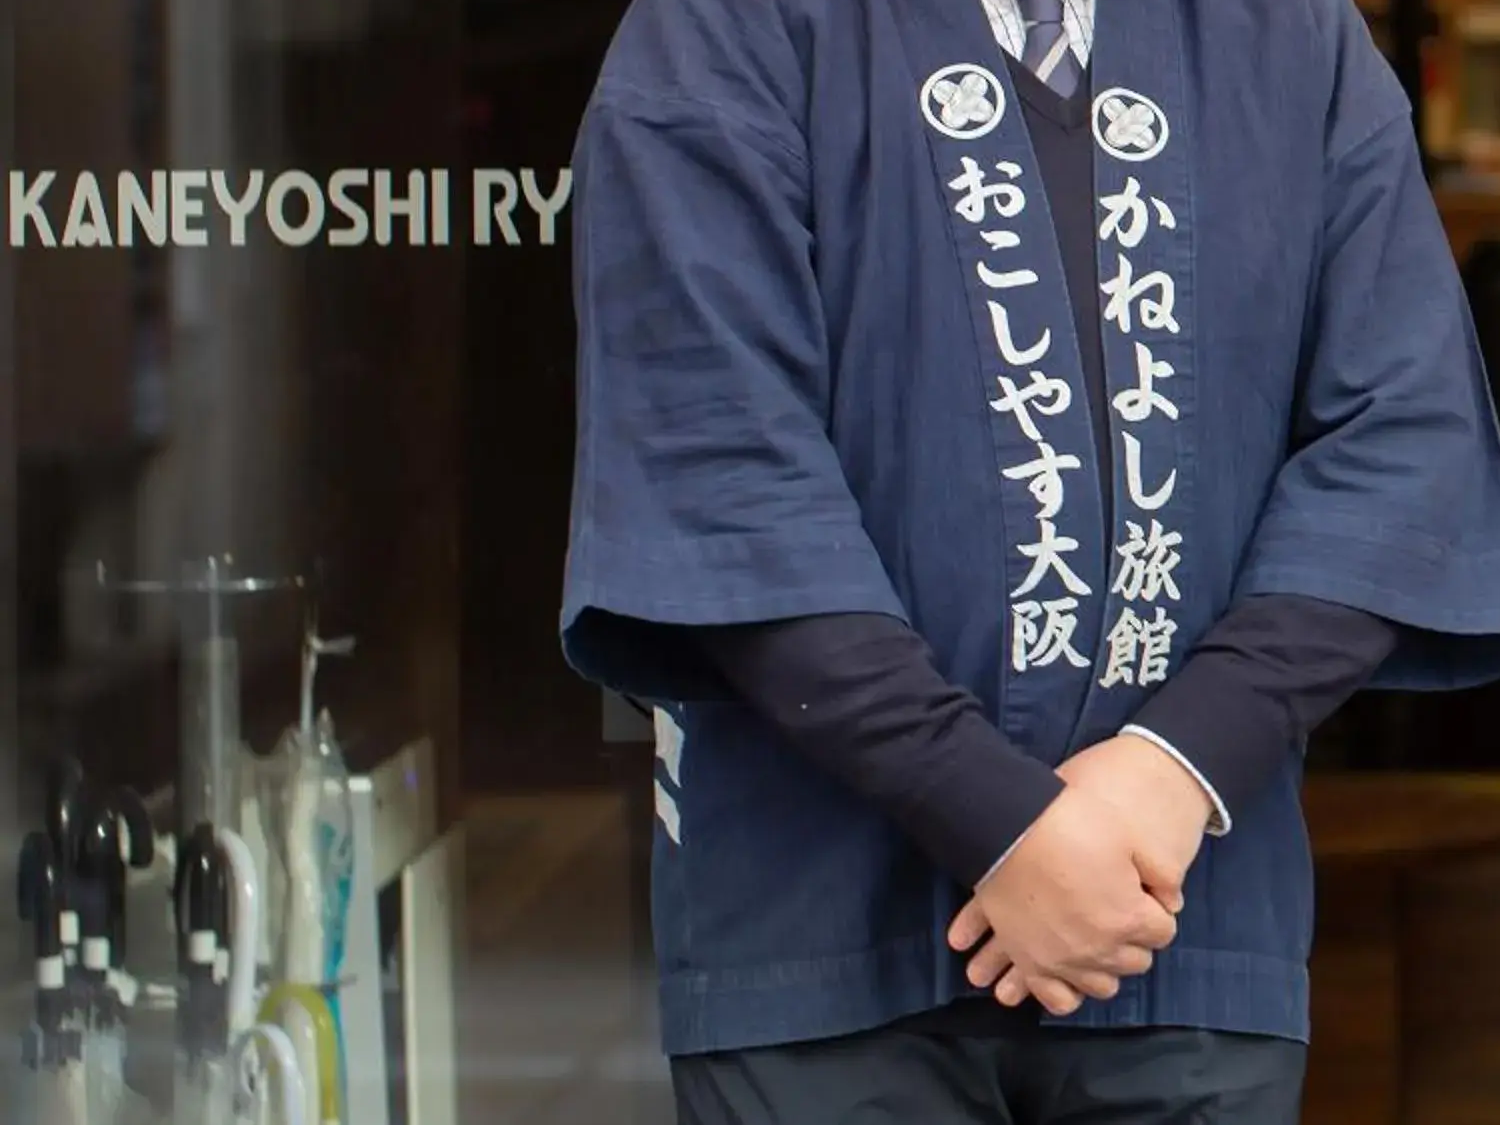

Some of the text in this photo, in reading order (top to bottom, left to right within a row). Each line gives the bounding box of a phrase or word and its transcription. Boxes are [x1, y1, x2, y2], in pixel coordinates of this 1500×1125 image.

[9, 170, 449, 247] KANEYOSHI
[948, 156, 1092, 672] おこしやす大阪
[1098, 176, 1182, 688] かねよし旅館
